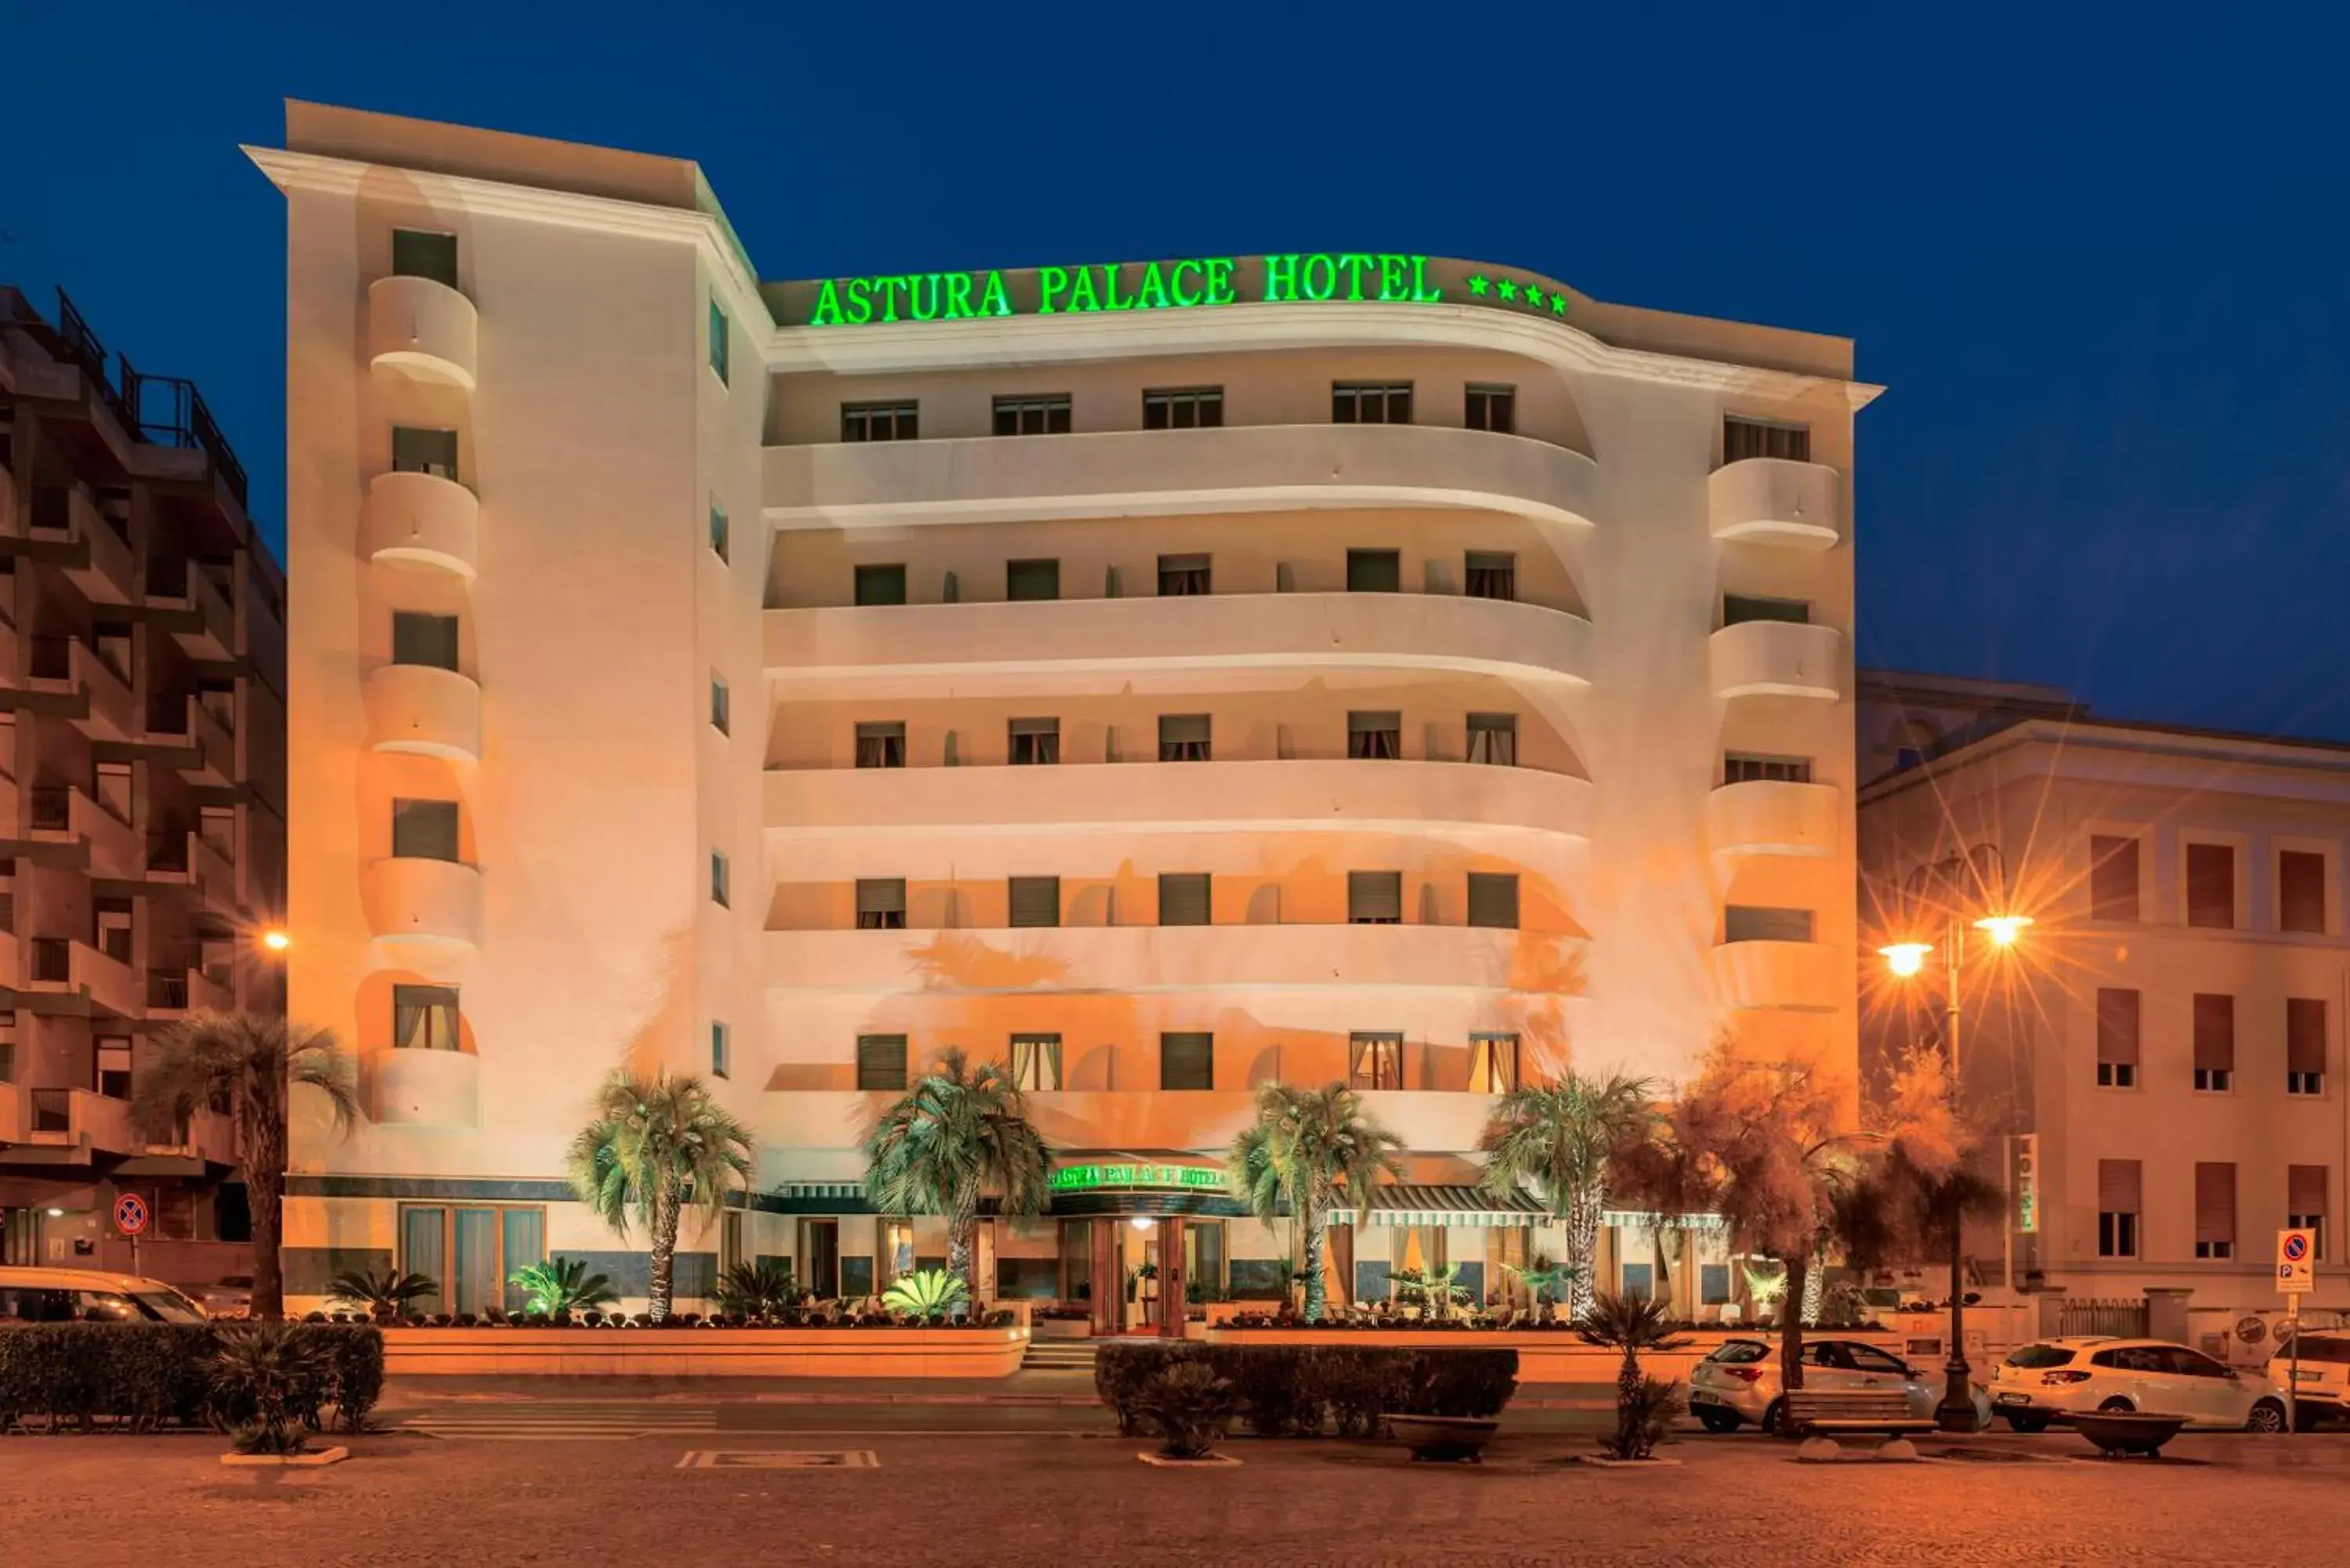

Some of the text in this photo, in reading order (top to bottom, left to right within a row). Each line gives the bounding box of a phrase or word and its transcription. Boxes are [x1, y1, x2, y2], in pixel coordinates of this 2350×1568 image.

[810, 253, 1442, 326] ASTURA PALACE HOTEL
